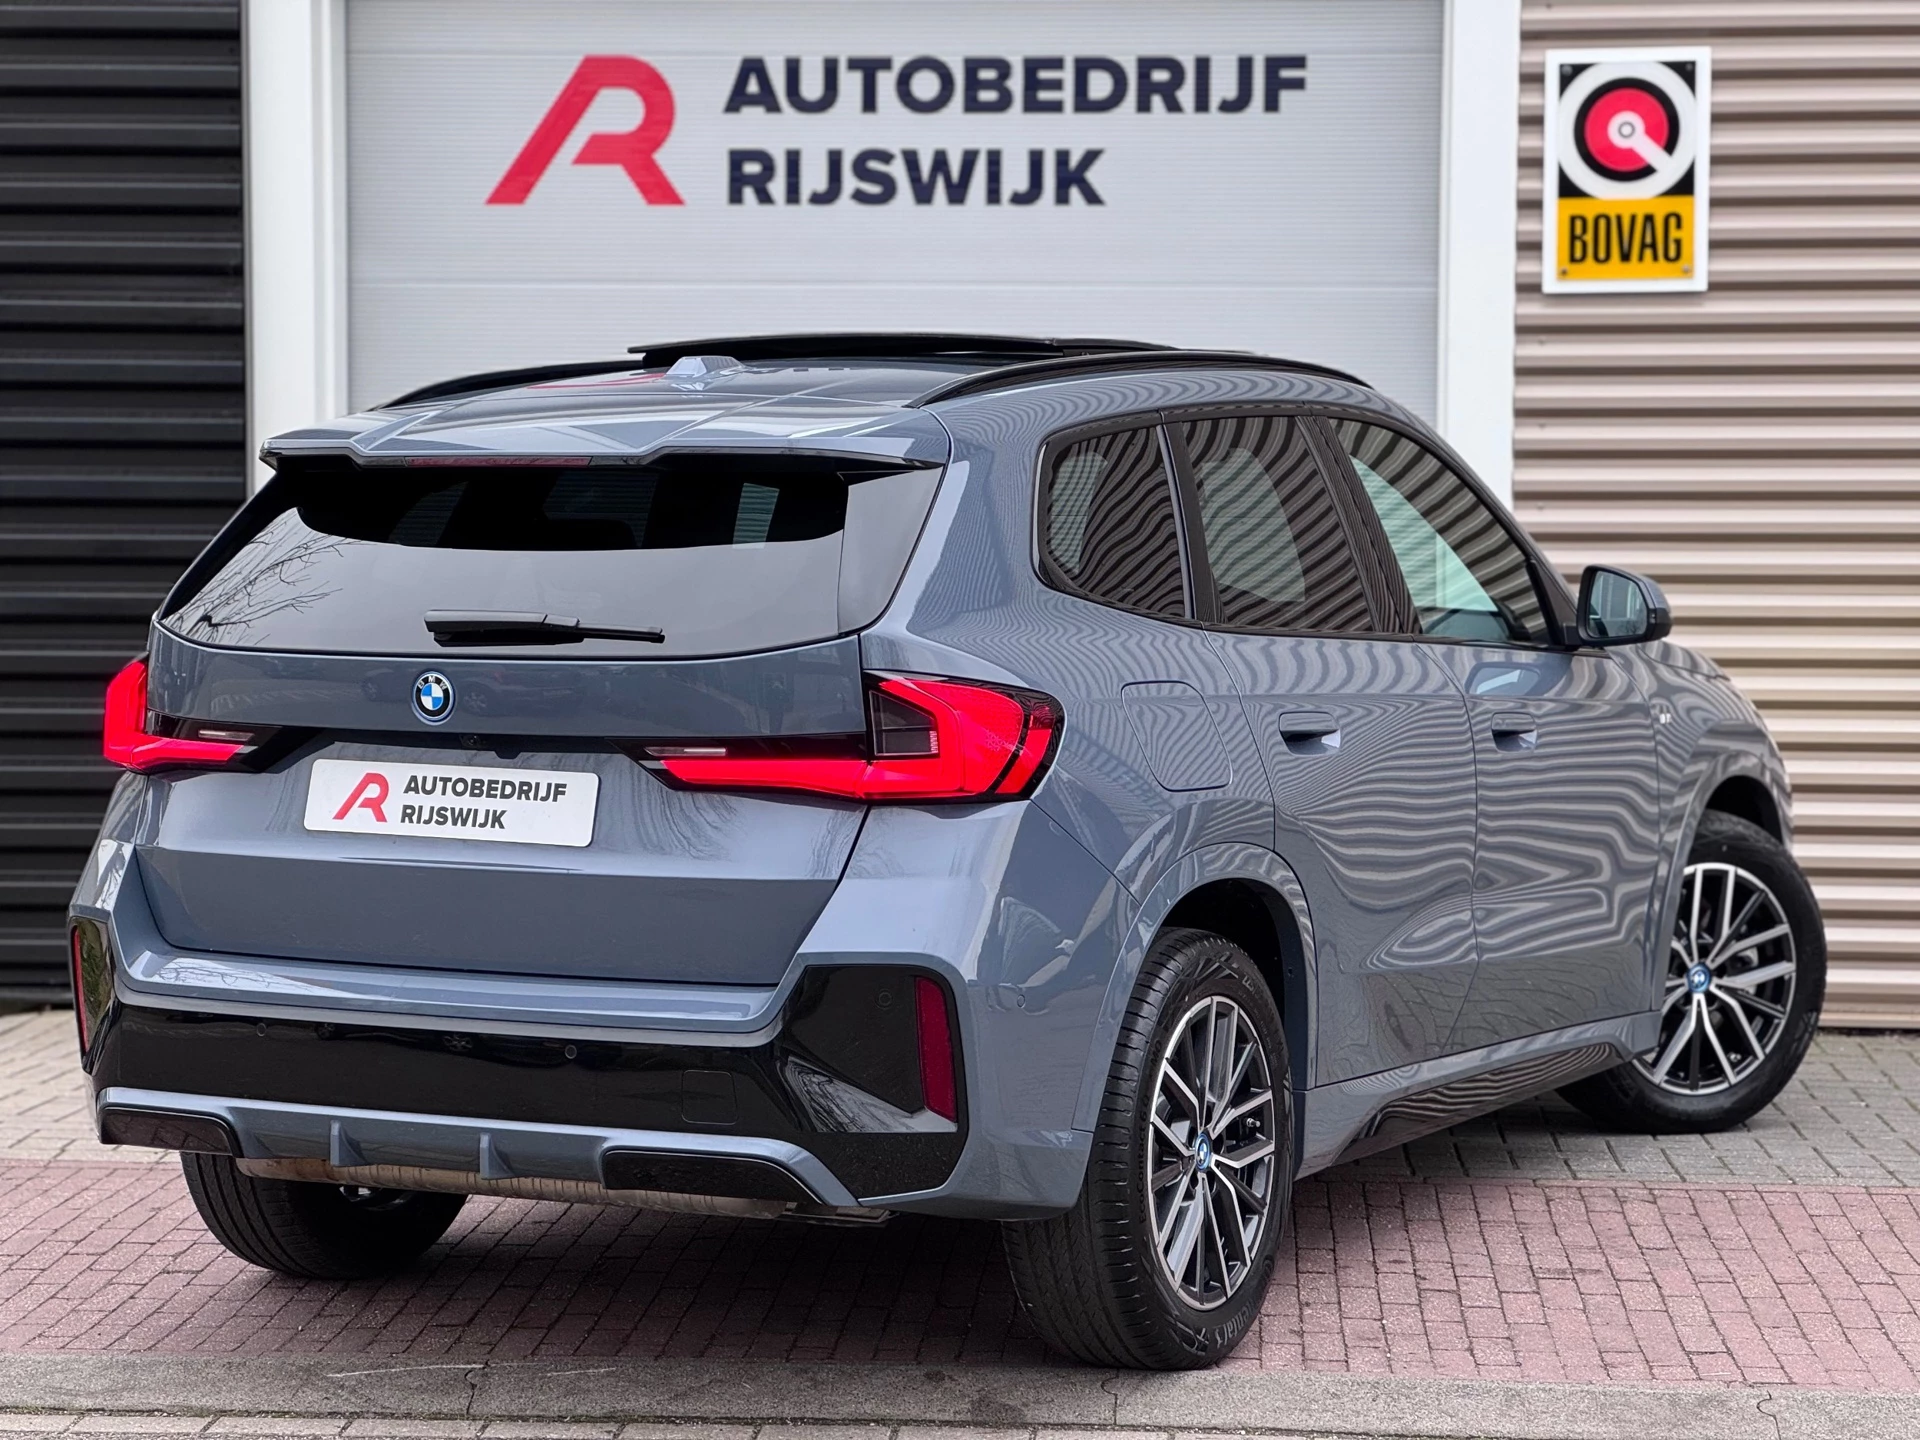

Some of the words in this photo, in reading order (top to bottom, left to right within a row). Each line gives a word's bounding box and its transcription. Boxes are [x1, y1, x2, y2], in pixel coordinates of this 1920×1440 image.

[723, 55, 1307, 115] AUTOBEDRIJF
[728, 148, 1105, 206] RIJSWIJK
[1569, 212, 1683, 265] BOVAG
[417, 675, 448, 690] BMW
[403, 774, 568, 803] AUTOBEDRIJF
[400, 804, 507, 830] RIJSWIJK
[1136, 1124, 1148, 1224] EcoContact
